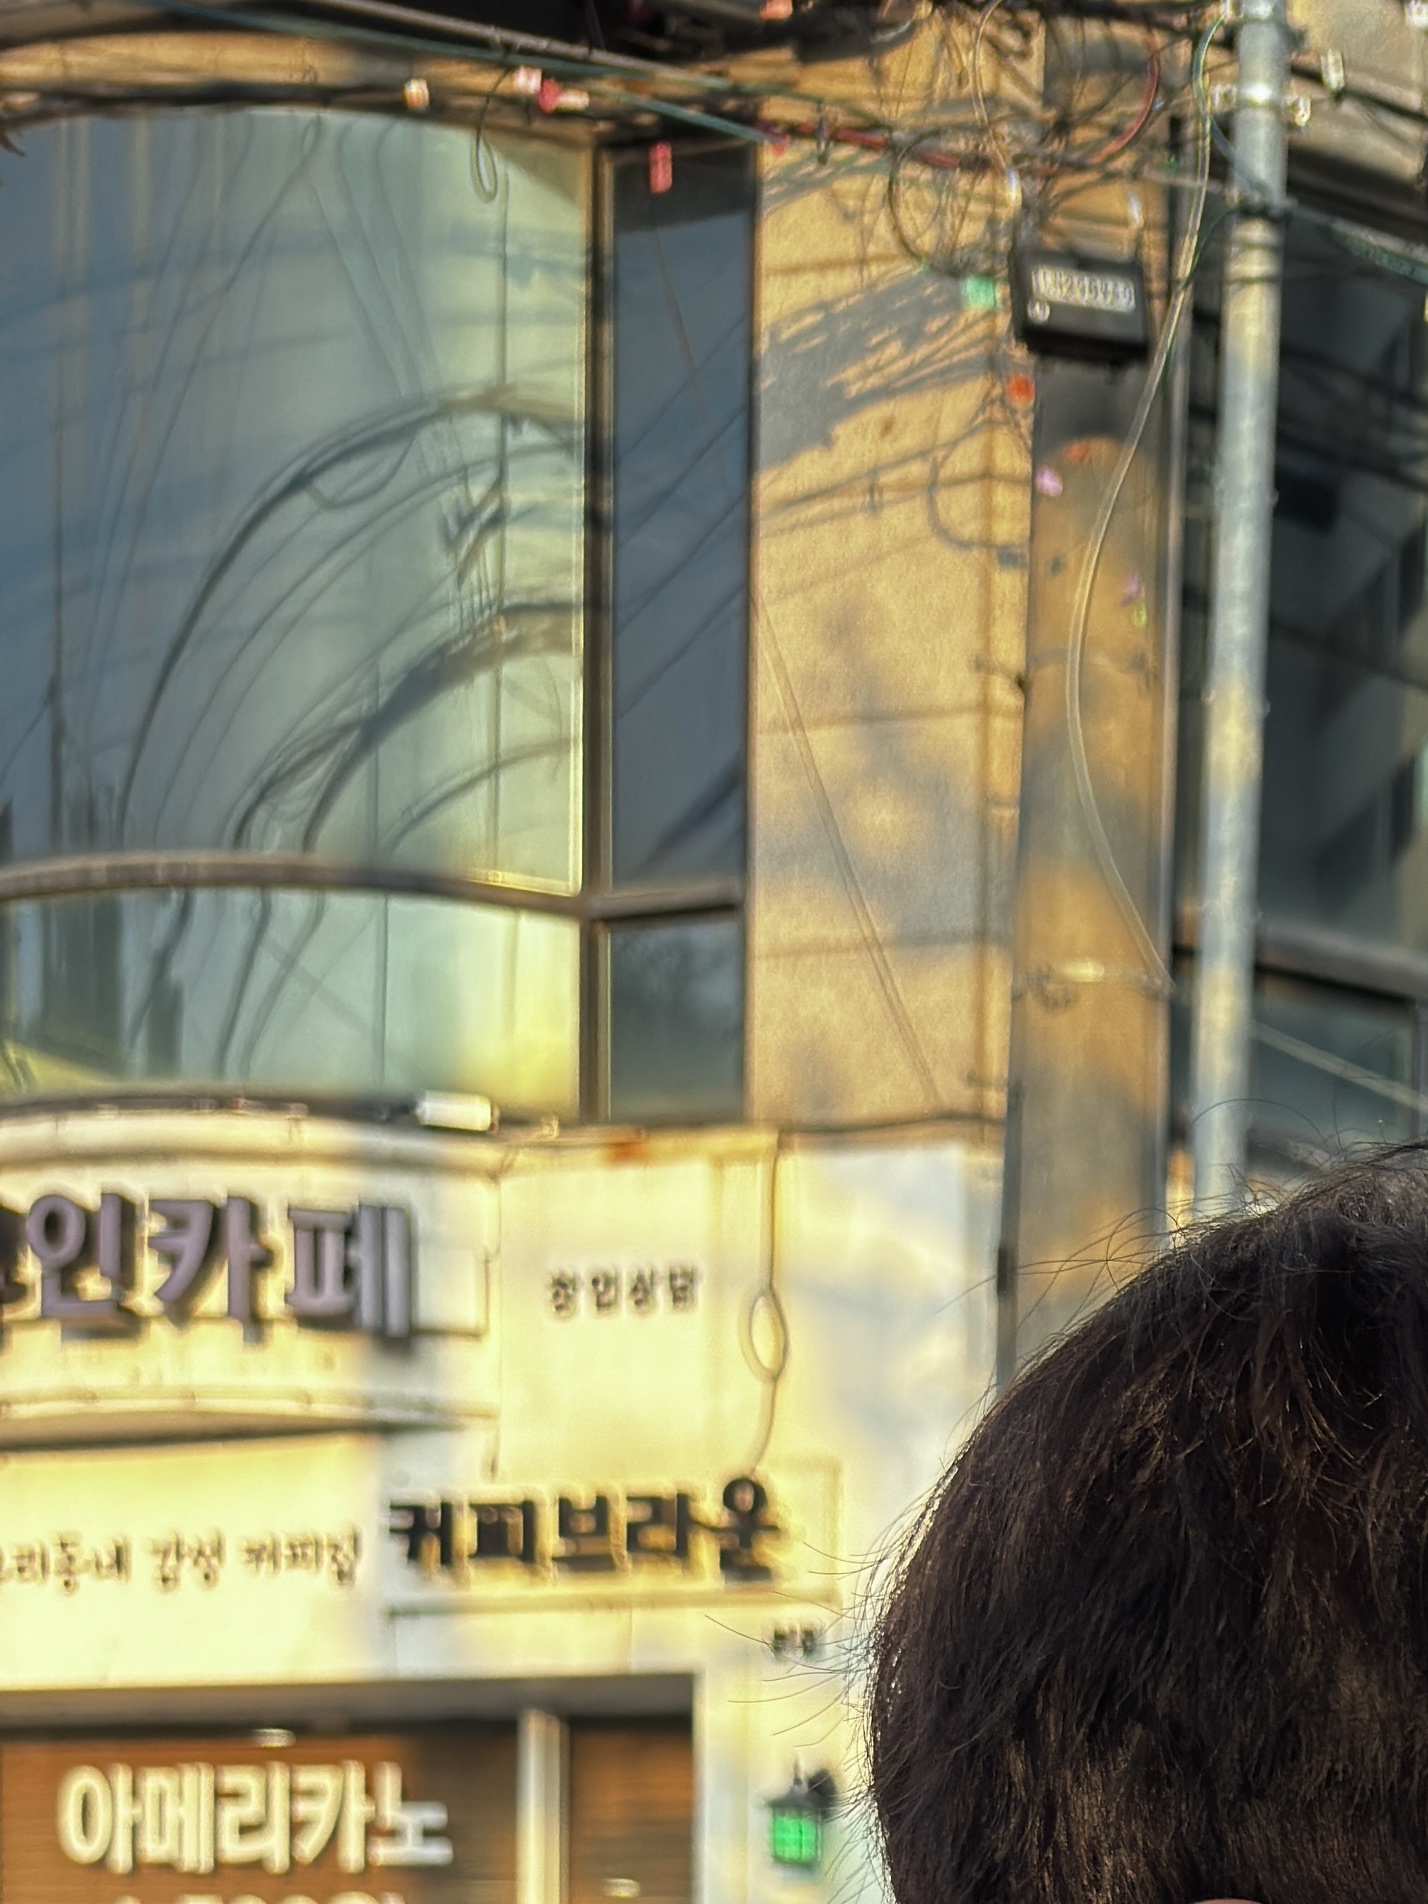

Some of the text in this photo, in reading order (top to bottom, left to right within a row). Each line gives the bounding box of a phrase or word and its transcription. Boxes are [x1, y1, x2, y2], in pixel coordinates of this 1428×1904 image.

[0, 1192, 412, 1338] 인카페
[389, 1477, 782, 1590] 커피브라운
[56, 1759, 454, 1875] 아메리카노
